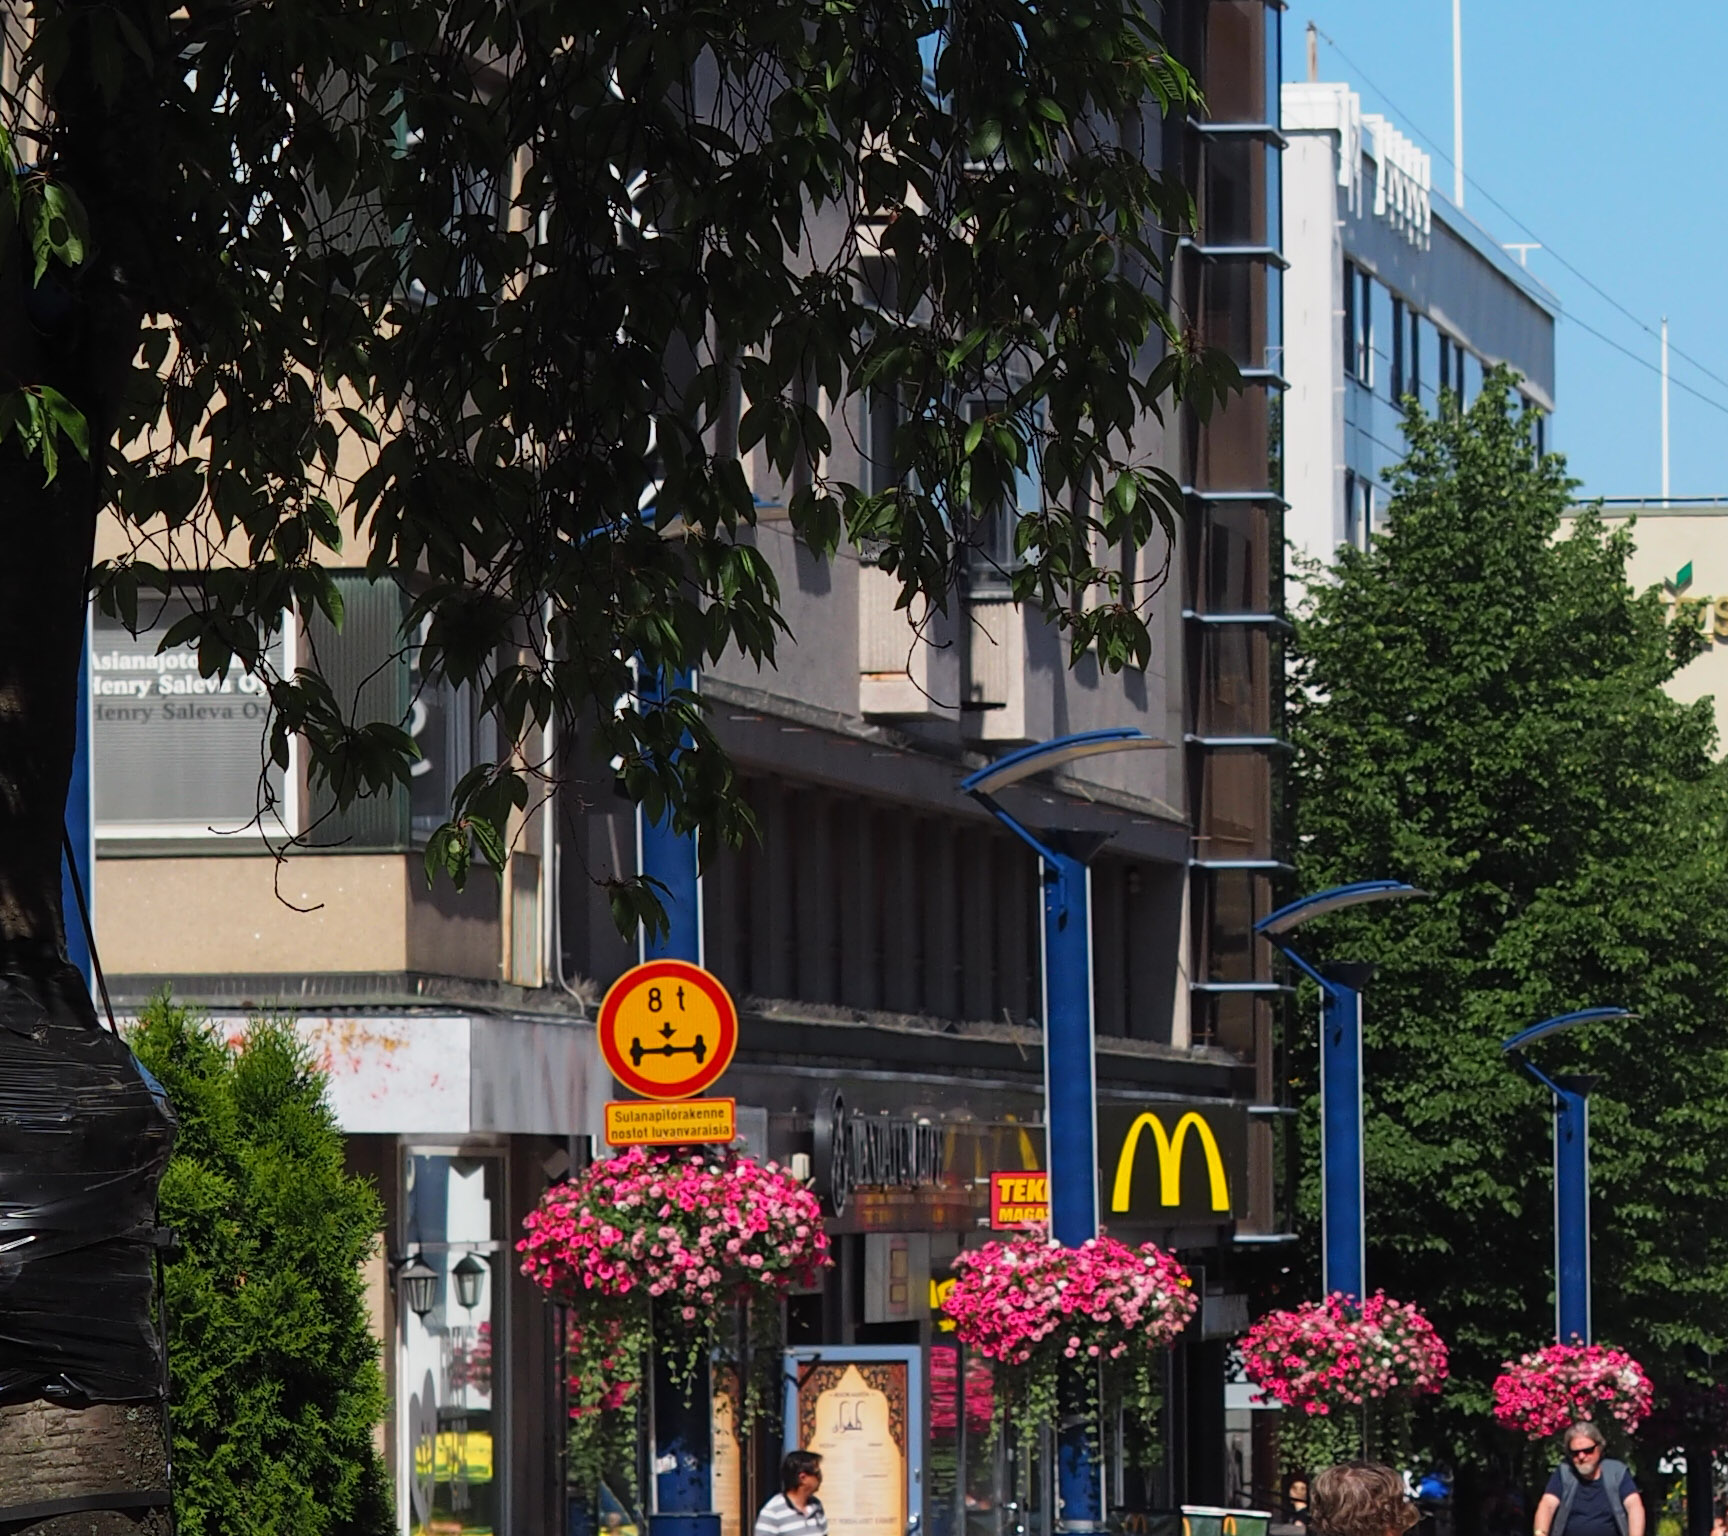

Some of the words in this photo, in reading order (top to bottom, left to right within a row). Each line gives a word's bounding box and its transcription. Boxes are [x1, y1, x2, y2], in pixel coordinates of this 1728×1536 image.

[158, 674, 232, 695] Saleva
[648, 987, 662, 1013] 8
[676, 985, 685, 1012] t
[614, 1107, 725, 1125] Sulanapitorakenne
[611, 1127, 648, 1140] nostot
[651, 1124, 730, 1139] luvanvaraisia
[997, 1177, 1048, 1204] TEK
